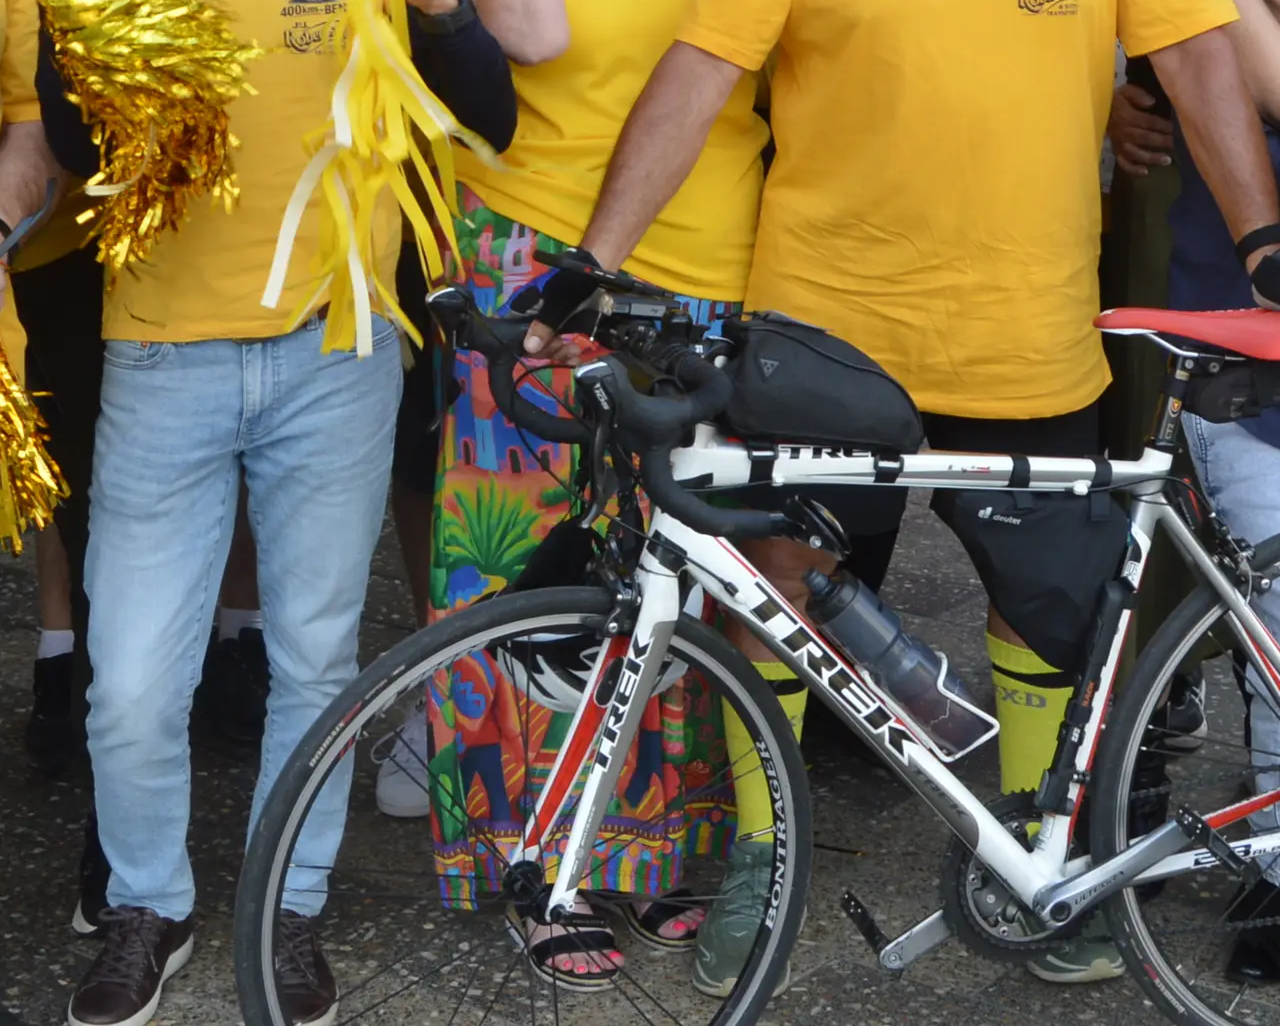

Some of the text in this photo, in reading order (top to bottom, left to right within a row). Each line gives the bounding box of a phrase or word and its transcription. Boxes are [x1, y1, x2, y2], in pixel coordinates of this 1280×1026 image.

[778, 444, 872, 460] TRE
[993, 515, 1022, 526] deuter
[592, 632, 655, 773] TREK
[750, 581, 920, 765] TREK
[754, 737, 787, 929] BONTRAGER
